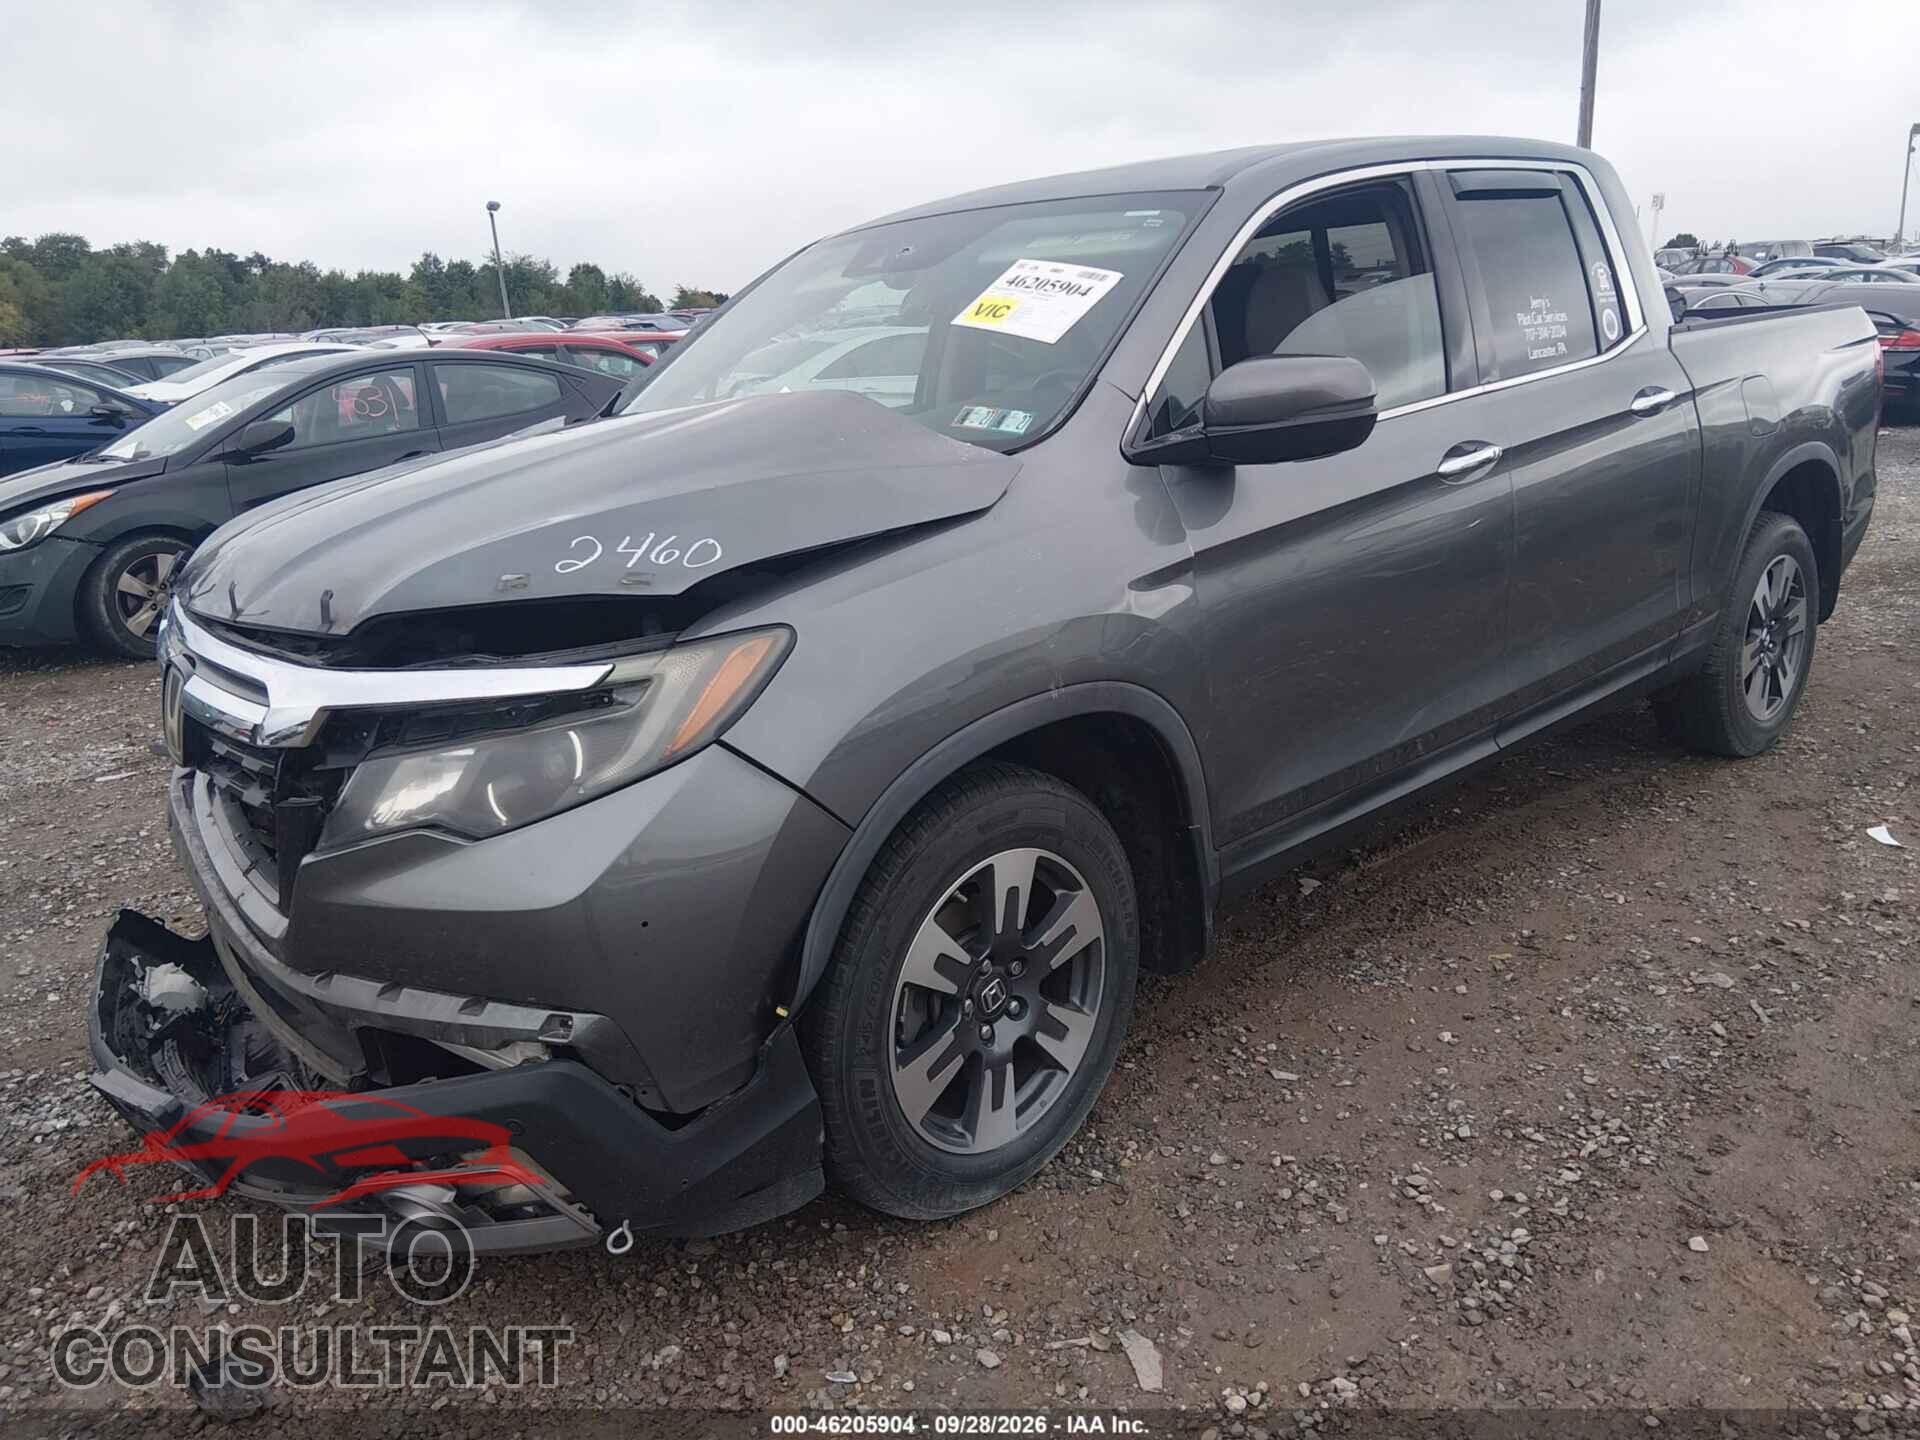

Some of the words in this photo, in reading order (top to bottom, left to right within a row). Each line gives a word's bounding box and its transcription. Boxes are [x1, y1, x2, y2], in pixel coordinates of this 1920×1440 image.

[1005, 274, 1094, 297] 46205904
[974, 303, 1011, 319] VIC
[555, 532, 722, 574] 2460
